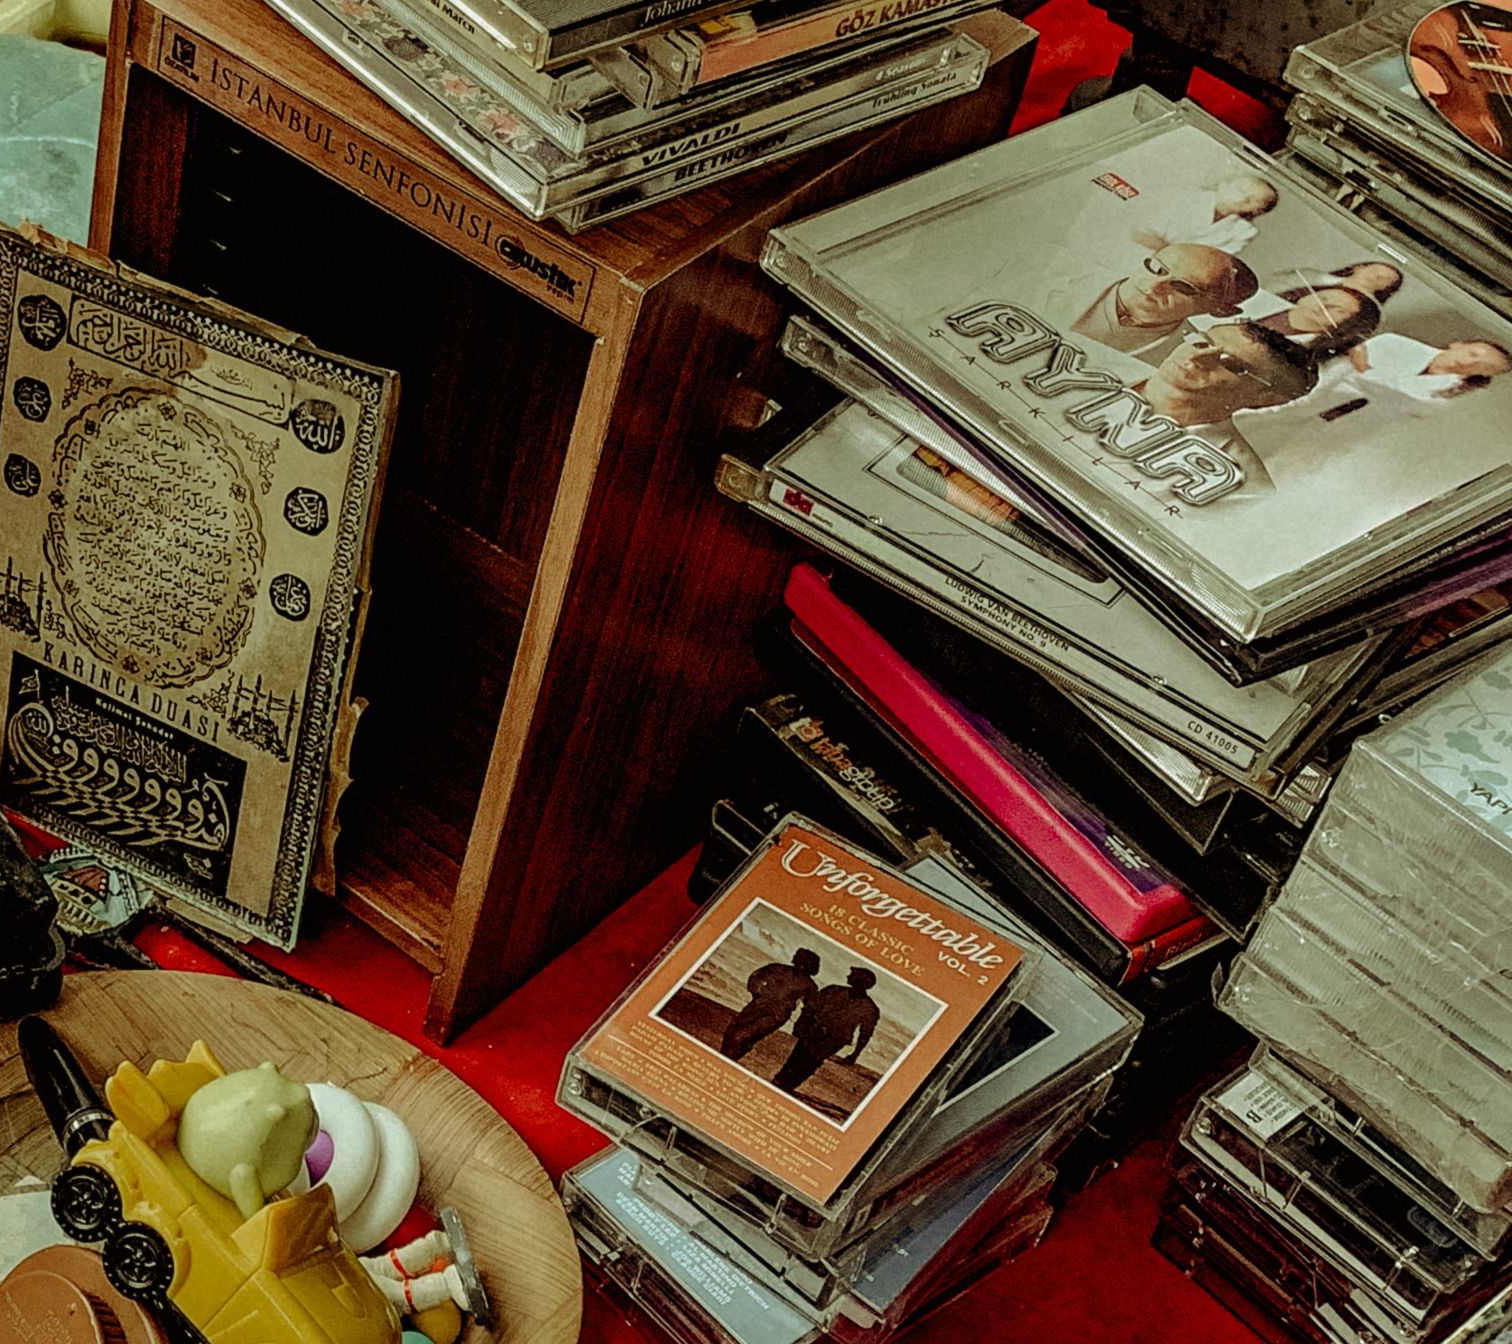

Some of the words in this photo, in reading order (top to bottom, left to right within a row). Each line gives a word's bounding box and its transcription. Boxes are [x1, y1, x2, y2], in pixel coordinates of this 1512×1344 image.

[835, 9, 875, 38] GÖZ
[641, 122, 741, 166] VIVALDI
[674, 137, 787, 181] BEETHOVEN
[947, 301, 1247, 508] AYNA
[943, 576, 985, 605] LUDWIG
[983, 597, 1011, 619] VAN
[1008, 612, 1071, 652] BEETHOVEN
[958, 594, 1018, 632] SYMPHONY
[1018, 627, 1039, 644] NO.
[1038, 639, 1047, 649] 9
[145, 692, 226, 743] DUASI
[1185, 719, 1204, 736] CD
[1203, 729, 1240, 755] 41005
[780, 838, 1005, 971] Unforgettable
[826, 901, 850, 921] 18
[849, 914, 915, 959] CLASSIC
[798, 899, 853, 938] SONGS
[854, 931, 877, 951] OF
[878, 945, 926, 979] LOVE
[935, 949, 976, 980] VOL.
[976, 973, 990, 987] 2
